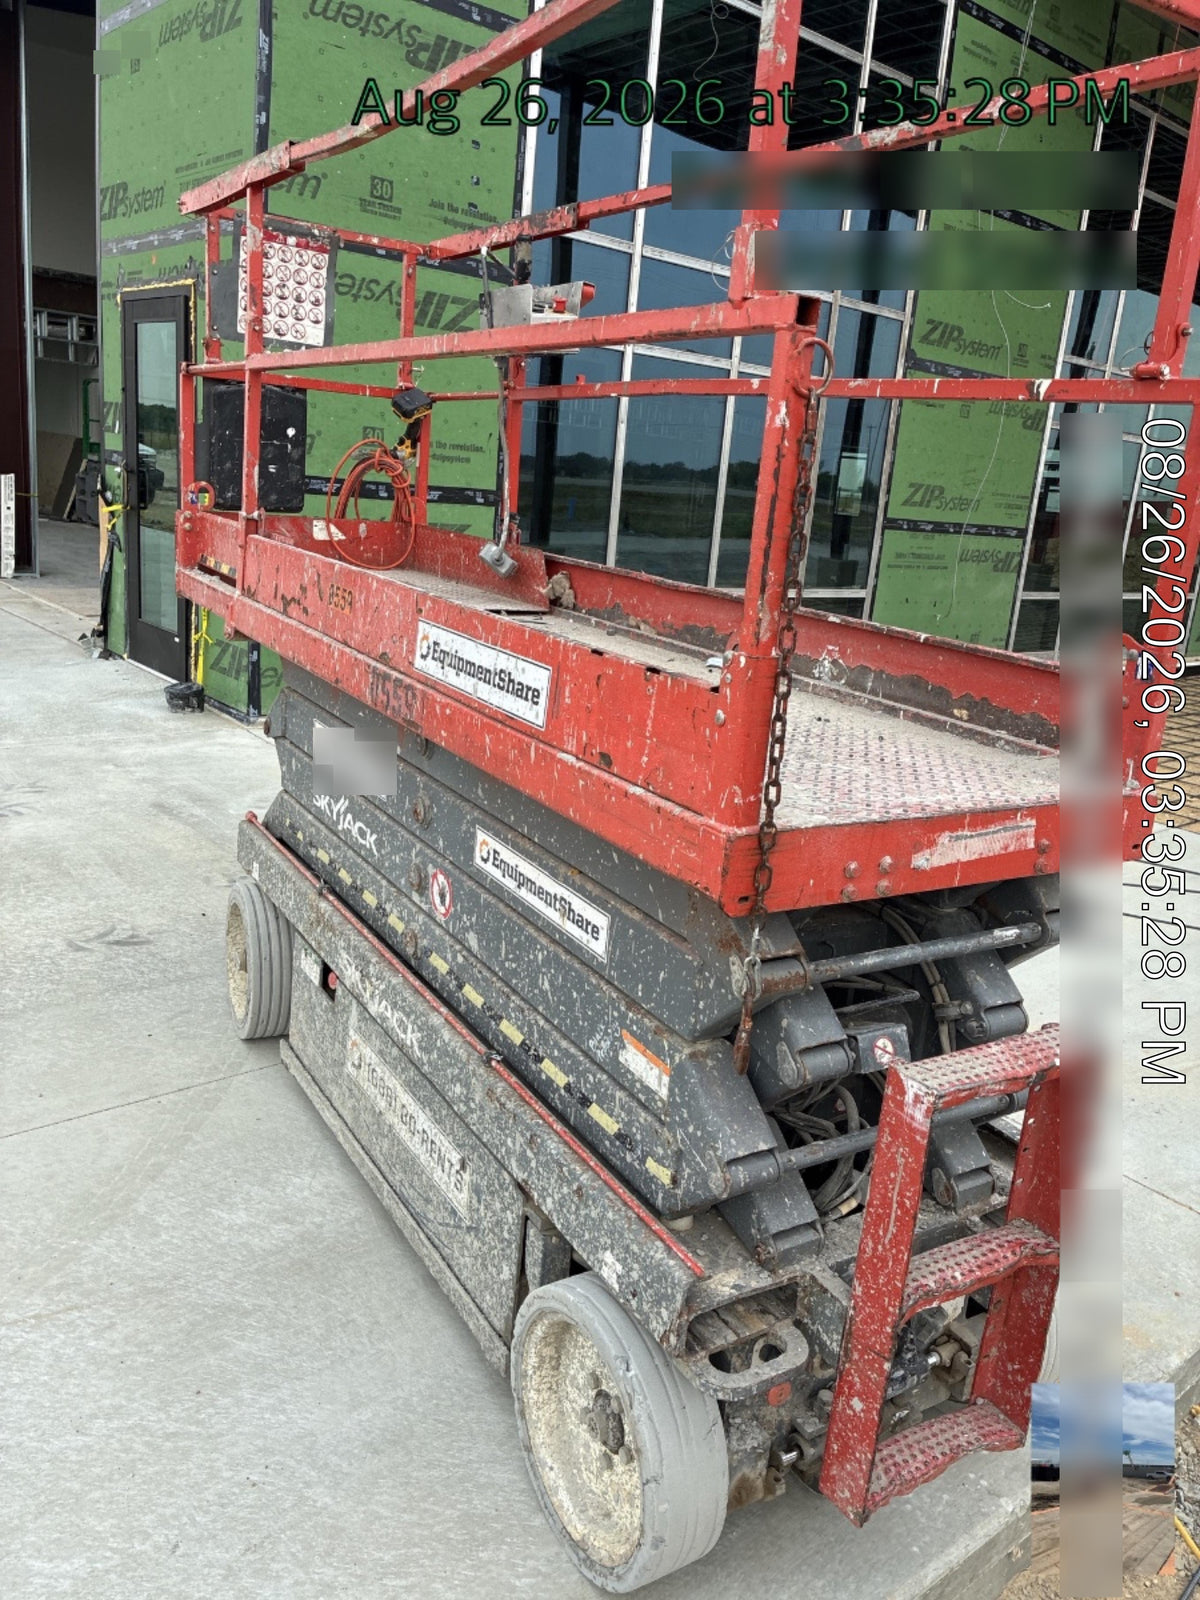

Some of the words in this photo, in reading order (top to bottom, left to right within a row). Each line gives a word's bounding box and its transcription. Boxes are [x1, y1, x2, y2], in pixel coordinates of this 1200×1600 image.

[370, 175, 393, 202] 30
[431, 640, 541, 706] EquipmentShare
[492, 848, 600, 942] EquipmentShare
